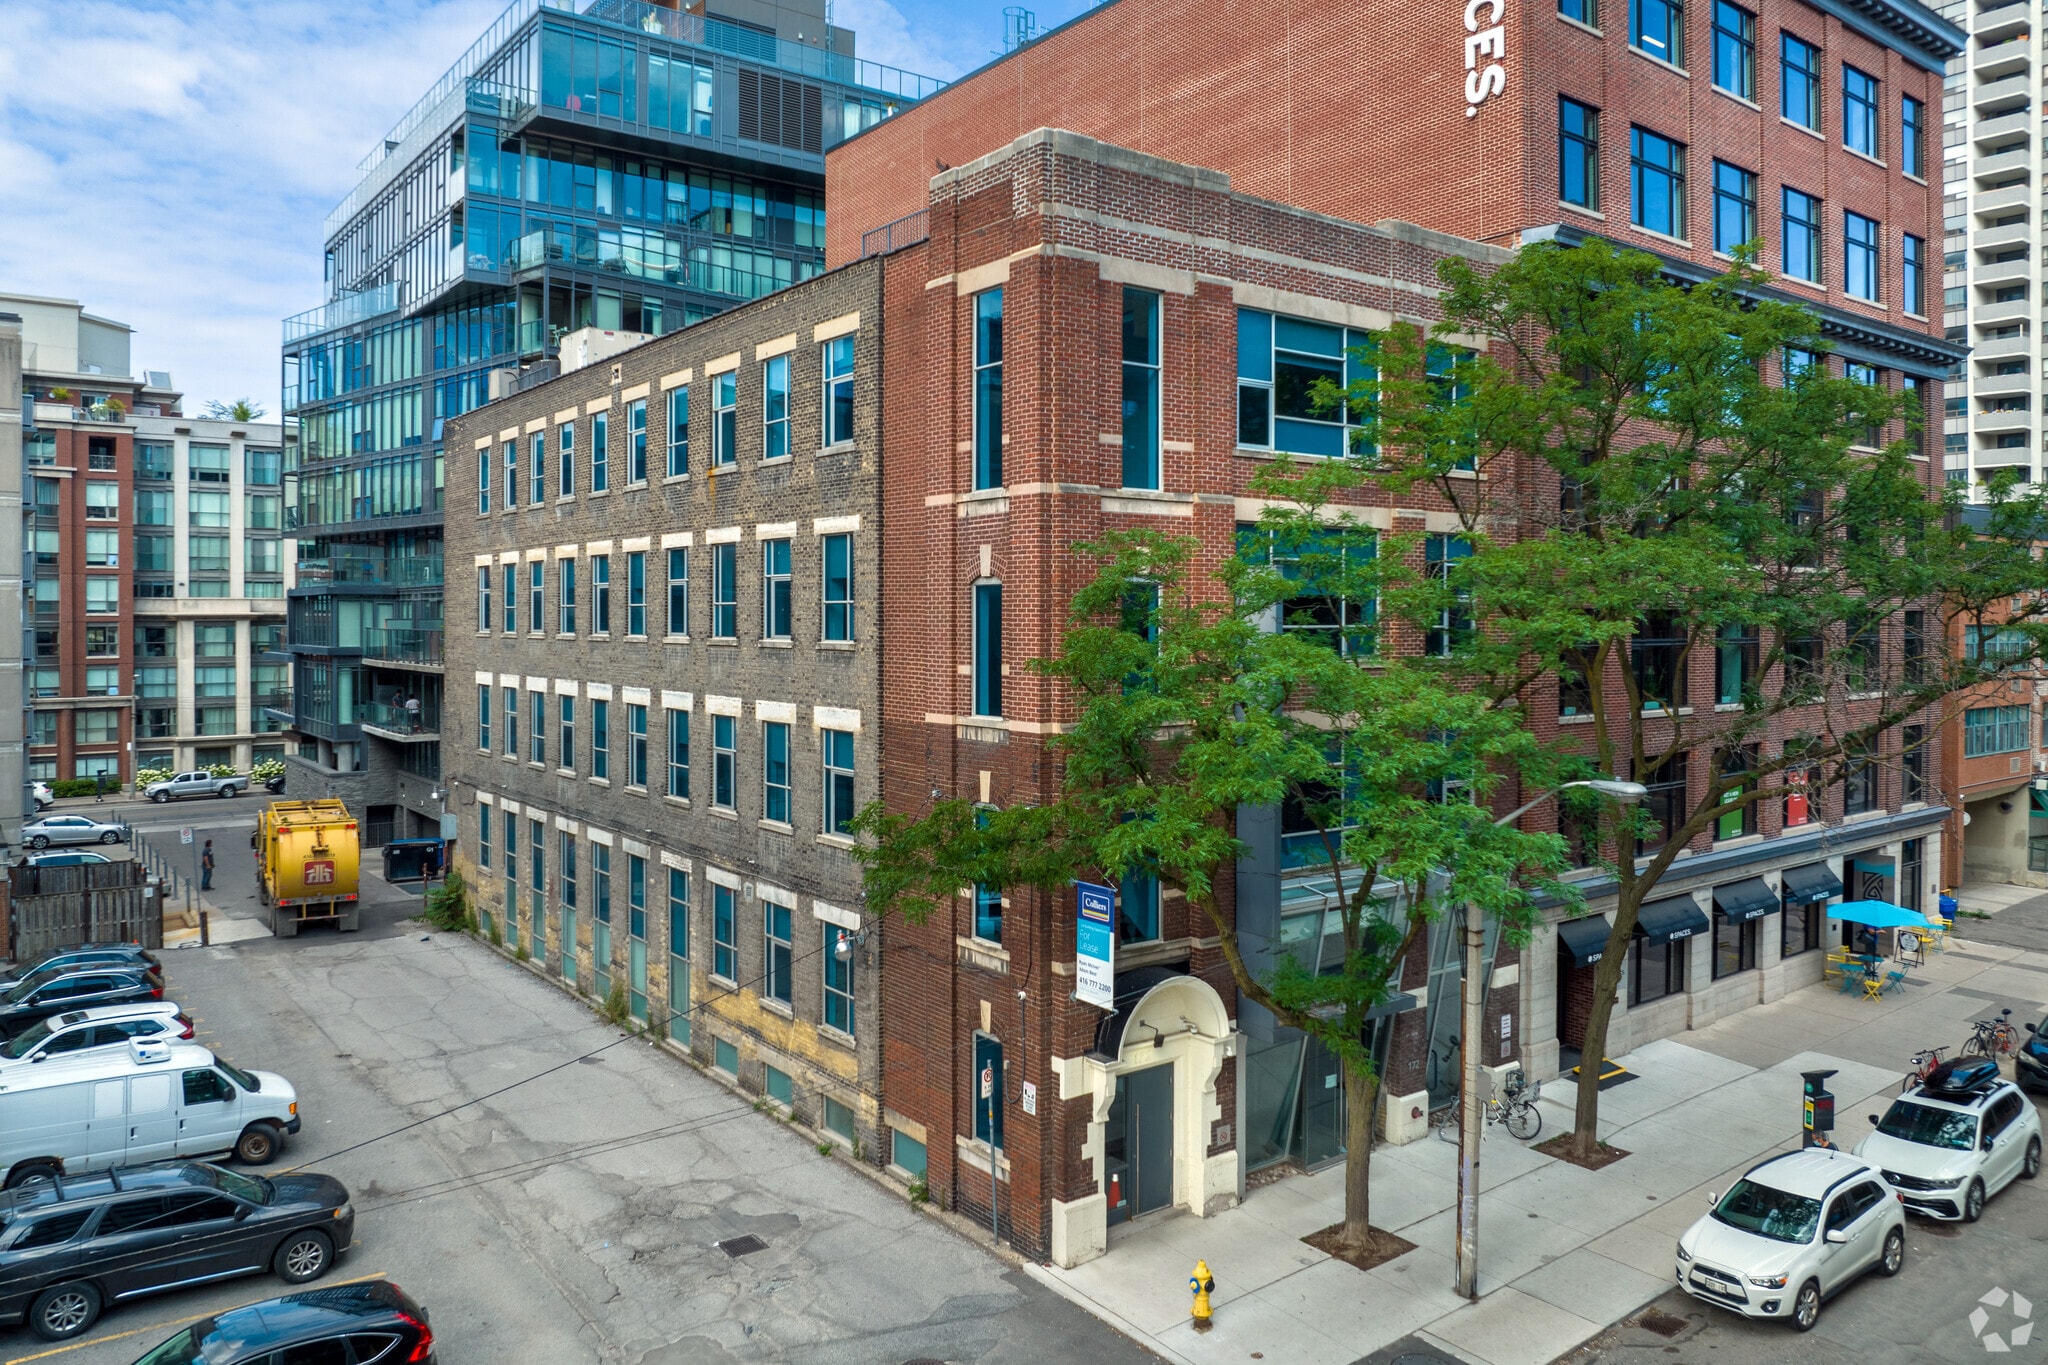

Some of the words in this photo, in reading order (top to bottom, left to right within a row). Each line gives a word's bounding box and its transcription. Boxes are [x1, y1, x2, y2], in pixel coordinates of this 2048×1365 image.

[1464, 0, 1505, 118] CES.
[1085, 897, 1107, 912] Colliers
[1080, 929, 1090, 940] For
[1080, 941, 1099, 954] Lease
[1592, 953, 1602, 962] SPA
[1080, 977, 1088, 986] 416
[1089, 980, 1098, 988] 777
[1098, 983, 1112, 993] 2200
[1408, 1059, 1420, 1071] 172
